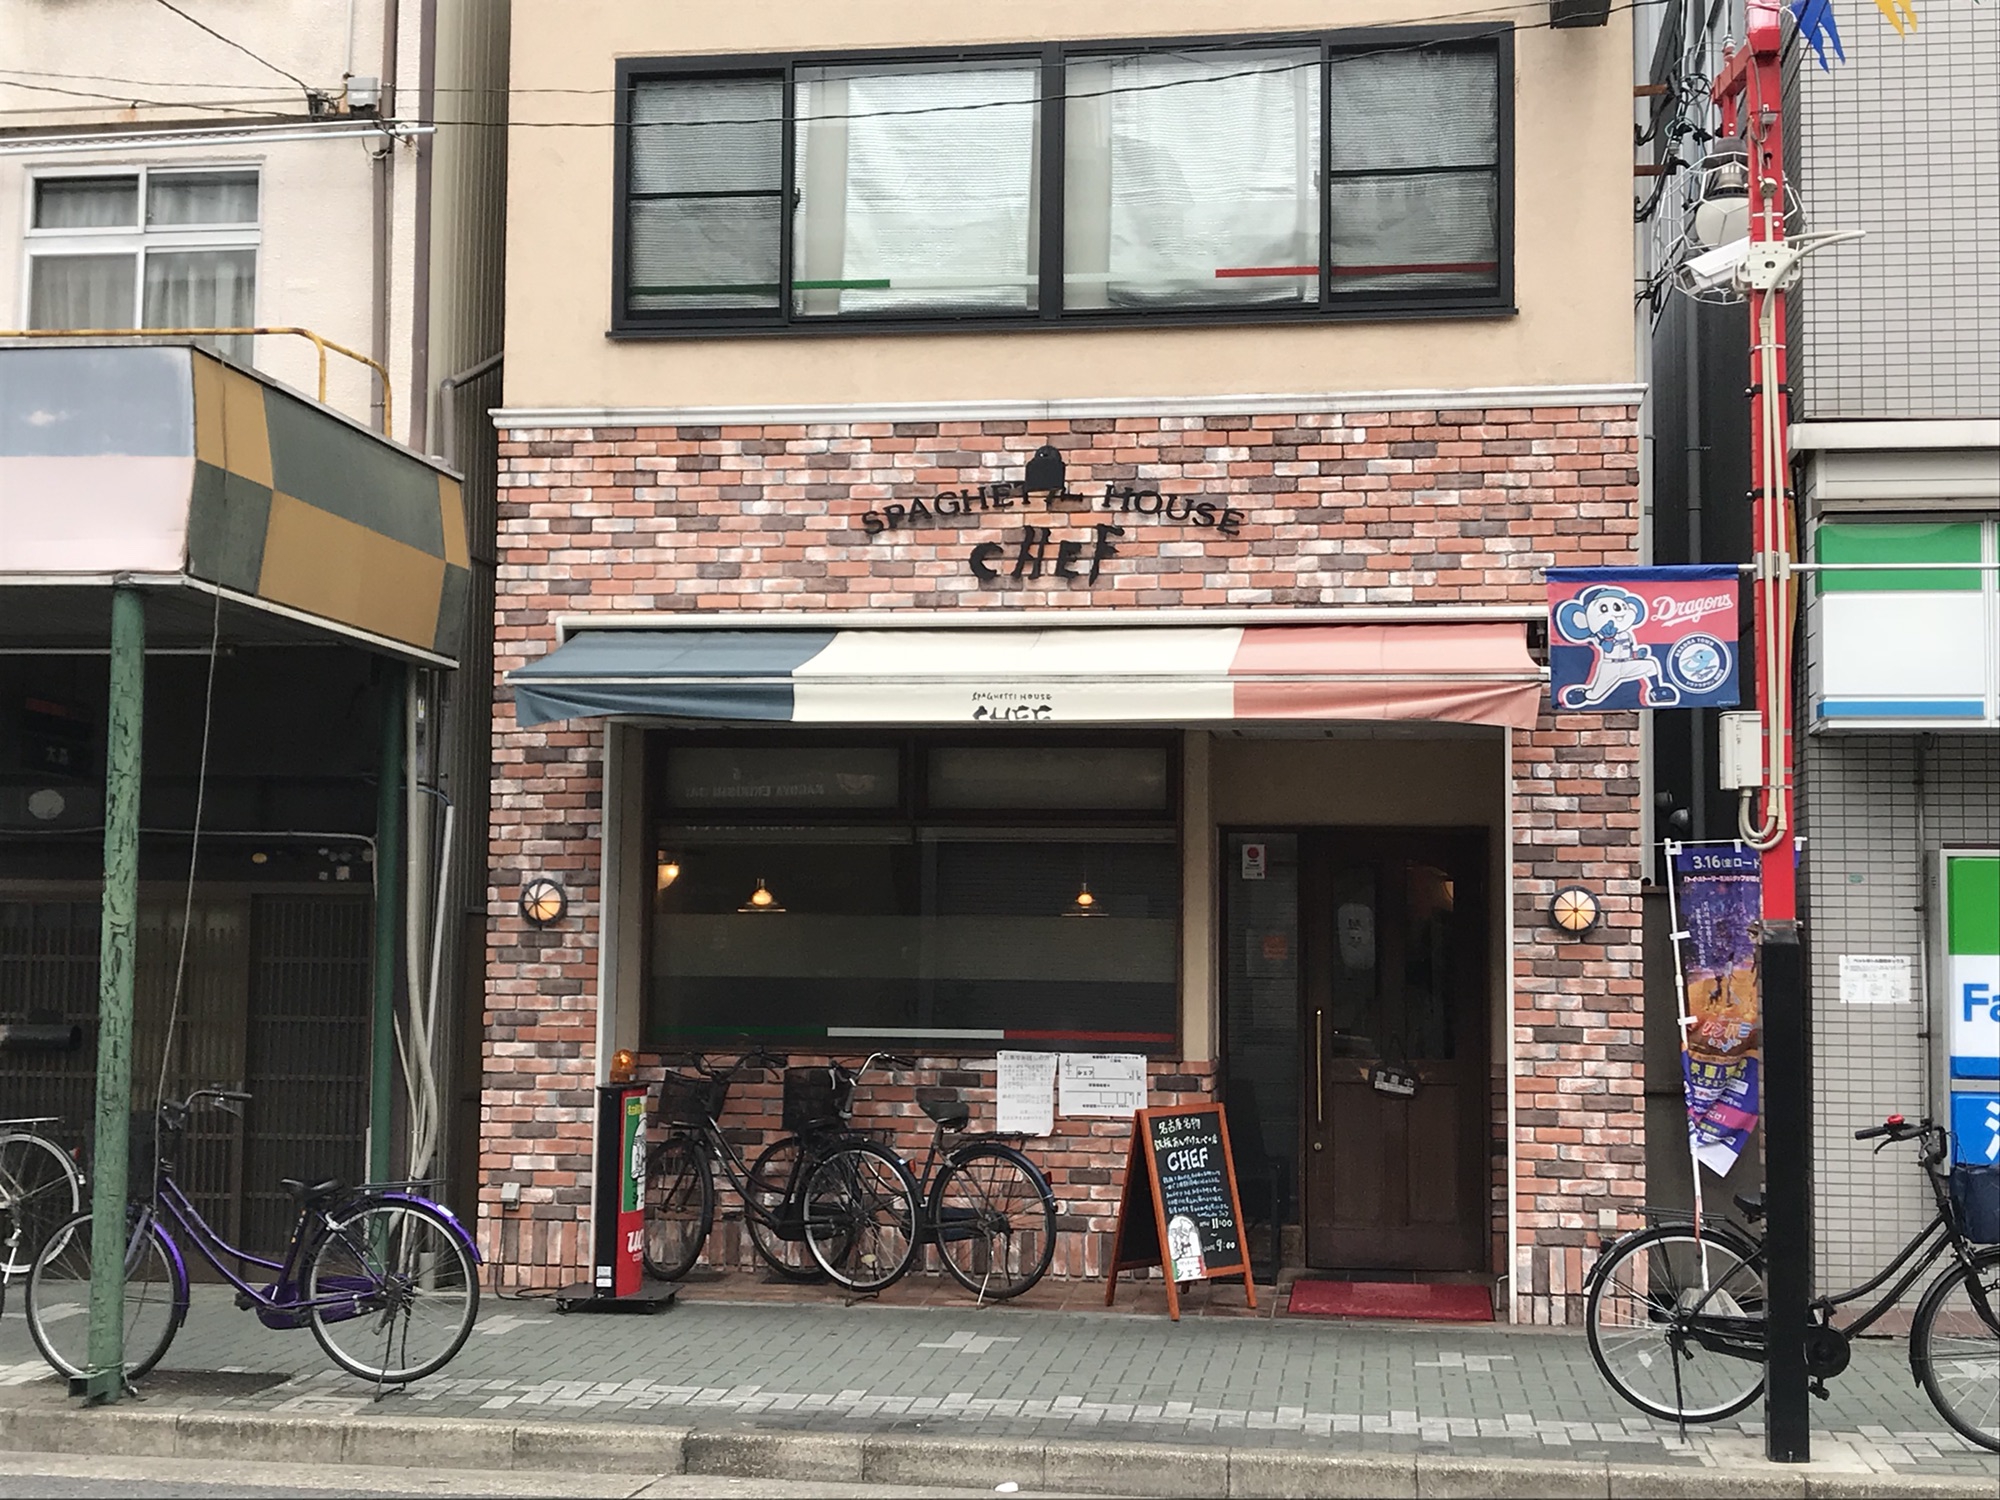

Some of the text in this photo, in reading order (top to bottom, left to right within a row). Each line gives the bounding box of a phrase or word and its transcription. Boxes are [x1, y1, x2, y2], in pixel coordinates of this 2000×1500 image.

[1102, 484, 1245, 536] HOUSE
[969, 523, 1125, 586] CHEF
[1651, 593, 1734, 627] Dragons
[971, 691, 1053, 701] SPAGHETTI HOUSE
[1158, 1117, 1201, 1135] 名古屋名物
[1167, 1147, 1208, 1171] CHEF
[1211, 1217, 1233, 1229] 11:00
[1216, 1238, 1236, 1252] 9:00
